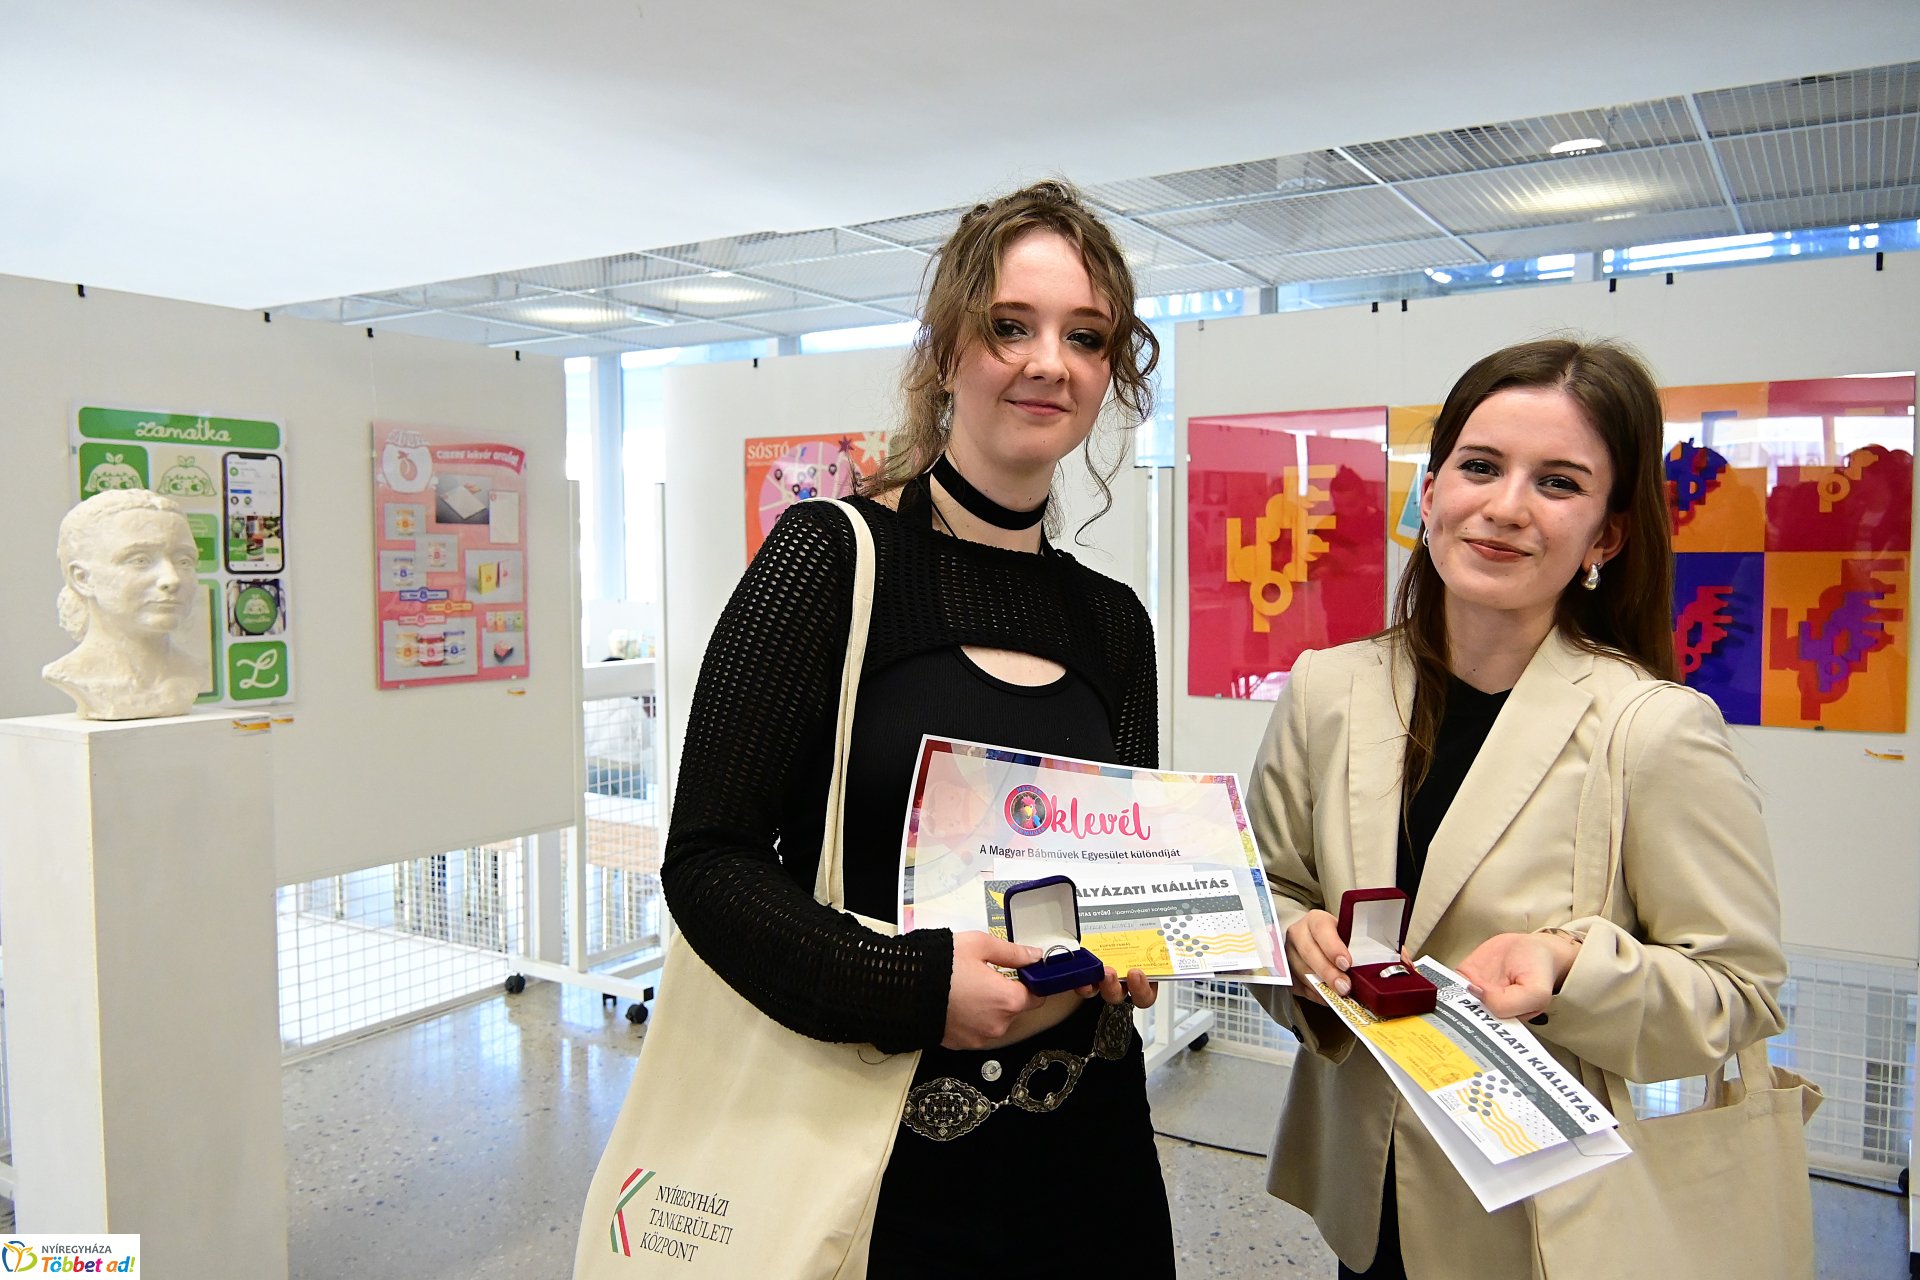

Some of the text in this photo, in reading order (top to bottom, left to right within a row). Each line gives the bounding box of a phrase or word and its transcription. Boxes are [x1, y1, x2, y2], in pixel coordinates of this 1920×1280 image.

[748, 441, 789, 460] SÓSTÓ
[979, 844, 1181, 862] A Magyar Bábművek Egyesület különdíját
[1152, 878, 1230, 895] KIÁLLÍTÁS
[1458, 999, 1529, 1054] PÁLYÁZATI
[1527, 1057, 1600, 1123] KIÁLLÍTÁS
[656, 1185, 730, 1217] NYÍREGYHÁZI
[649, 1208, 733, 1245] TANKERÜLETI
[640, 1231, 699, 1262] KÖZPONT
